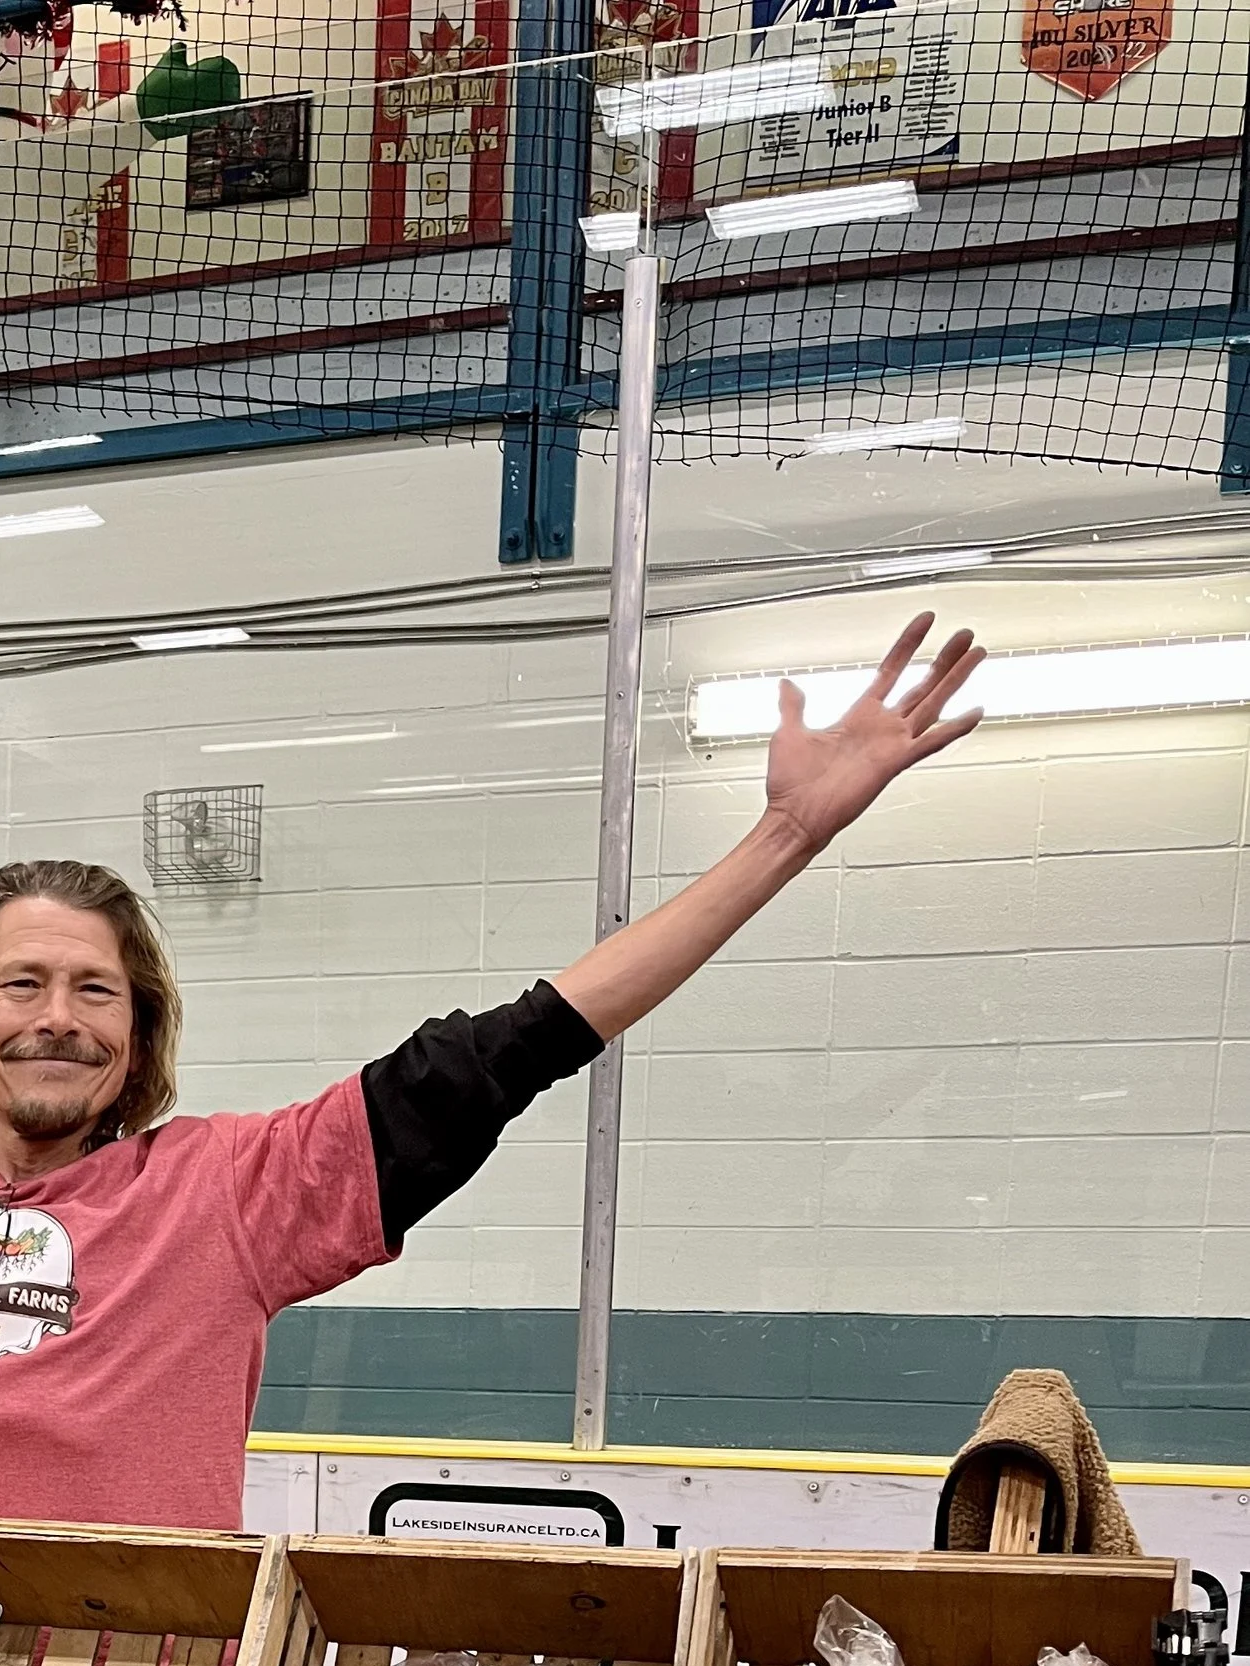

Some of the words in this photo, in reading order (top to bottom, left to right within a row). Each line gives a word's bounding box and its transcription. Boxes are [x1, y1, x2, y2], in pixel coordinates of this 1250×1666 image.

[1075, 17, 1160, 42] SILVER
[815, 98, 873, 121] Junior
[879, 95, 891, 113] B
[381, 126, 499, 162] BANTAM
[826, 128, 863, 148] Tier
[426, 172, 448, 206] B
[404, 215, 468, 242] 2017
[8, 1287, 70, 1314] FARMS
